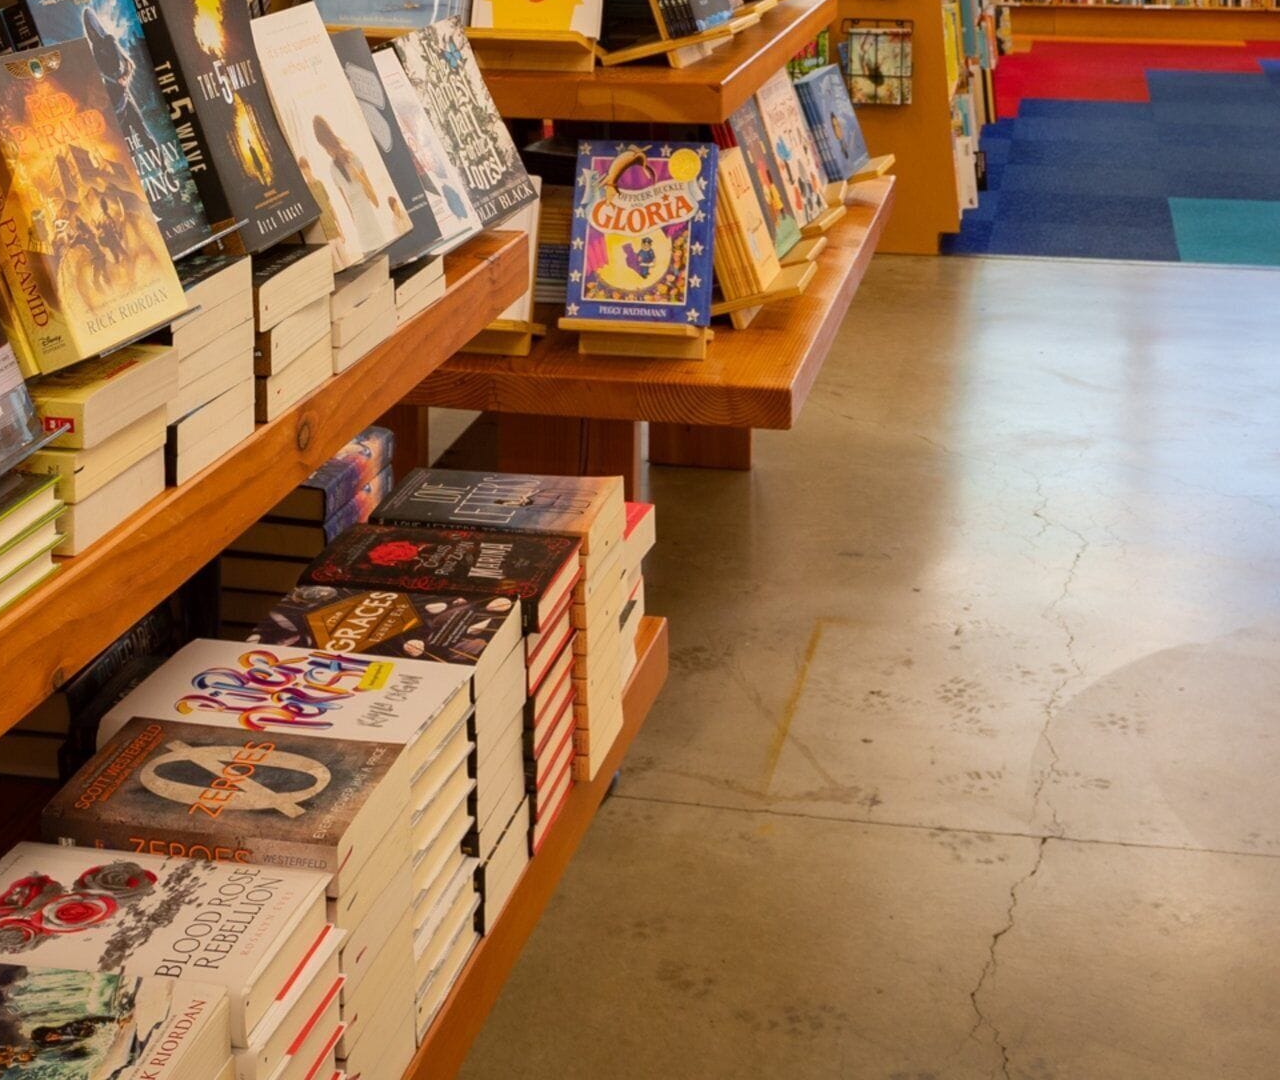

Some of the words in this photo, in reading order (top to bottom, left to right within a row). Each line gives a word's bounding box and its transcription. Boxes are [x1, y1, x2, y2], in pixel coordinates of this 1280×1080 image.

[196, 70, 220, 102] THE
[226, 58, 258, 93] WAVE
[155, 60, 180, 96] THE
[176, 121, 208, 175] WAVE
[500, 179, 535, 209] BLACK
[591, 195, 696, 235] GLORIA
[1, 216, 51, 330] PYRAMID
[86, 313, 117, 337] RICK
[119, 287, 170, 322] RIORDAN
[467, 541, 514, 580] MARINA
[324, 590, 400, 654] GRACES
[74, 774, 110, 811] SCOTT
[106, 723, 163, 781] WESTERFELD
[188, 739, 276, 819] ZEROES
[261, 853, 328, 871] WESTERFELD
[153, 911, 223, 980] BLOOD
[217, 867, 262, 909] ROSE
[193, 876, 285, 971] REBELLION
[149, 999, 207, 1067] RIORDAN
